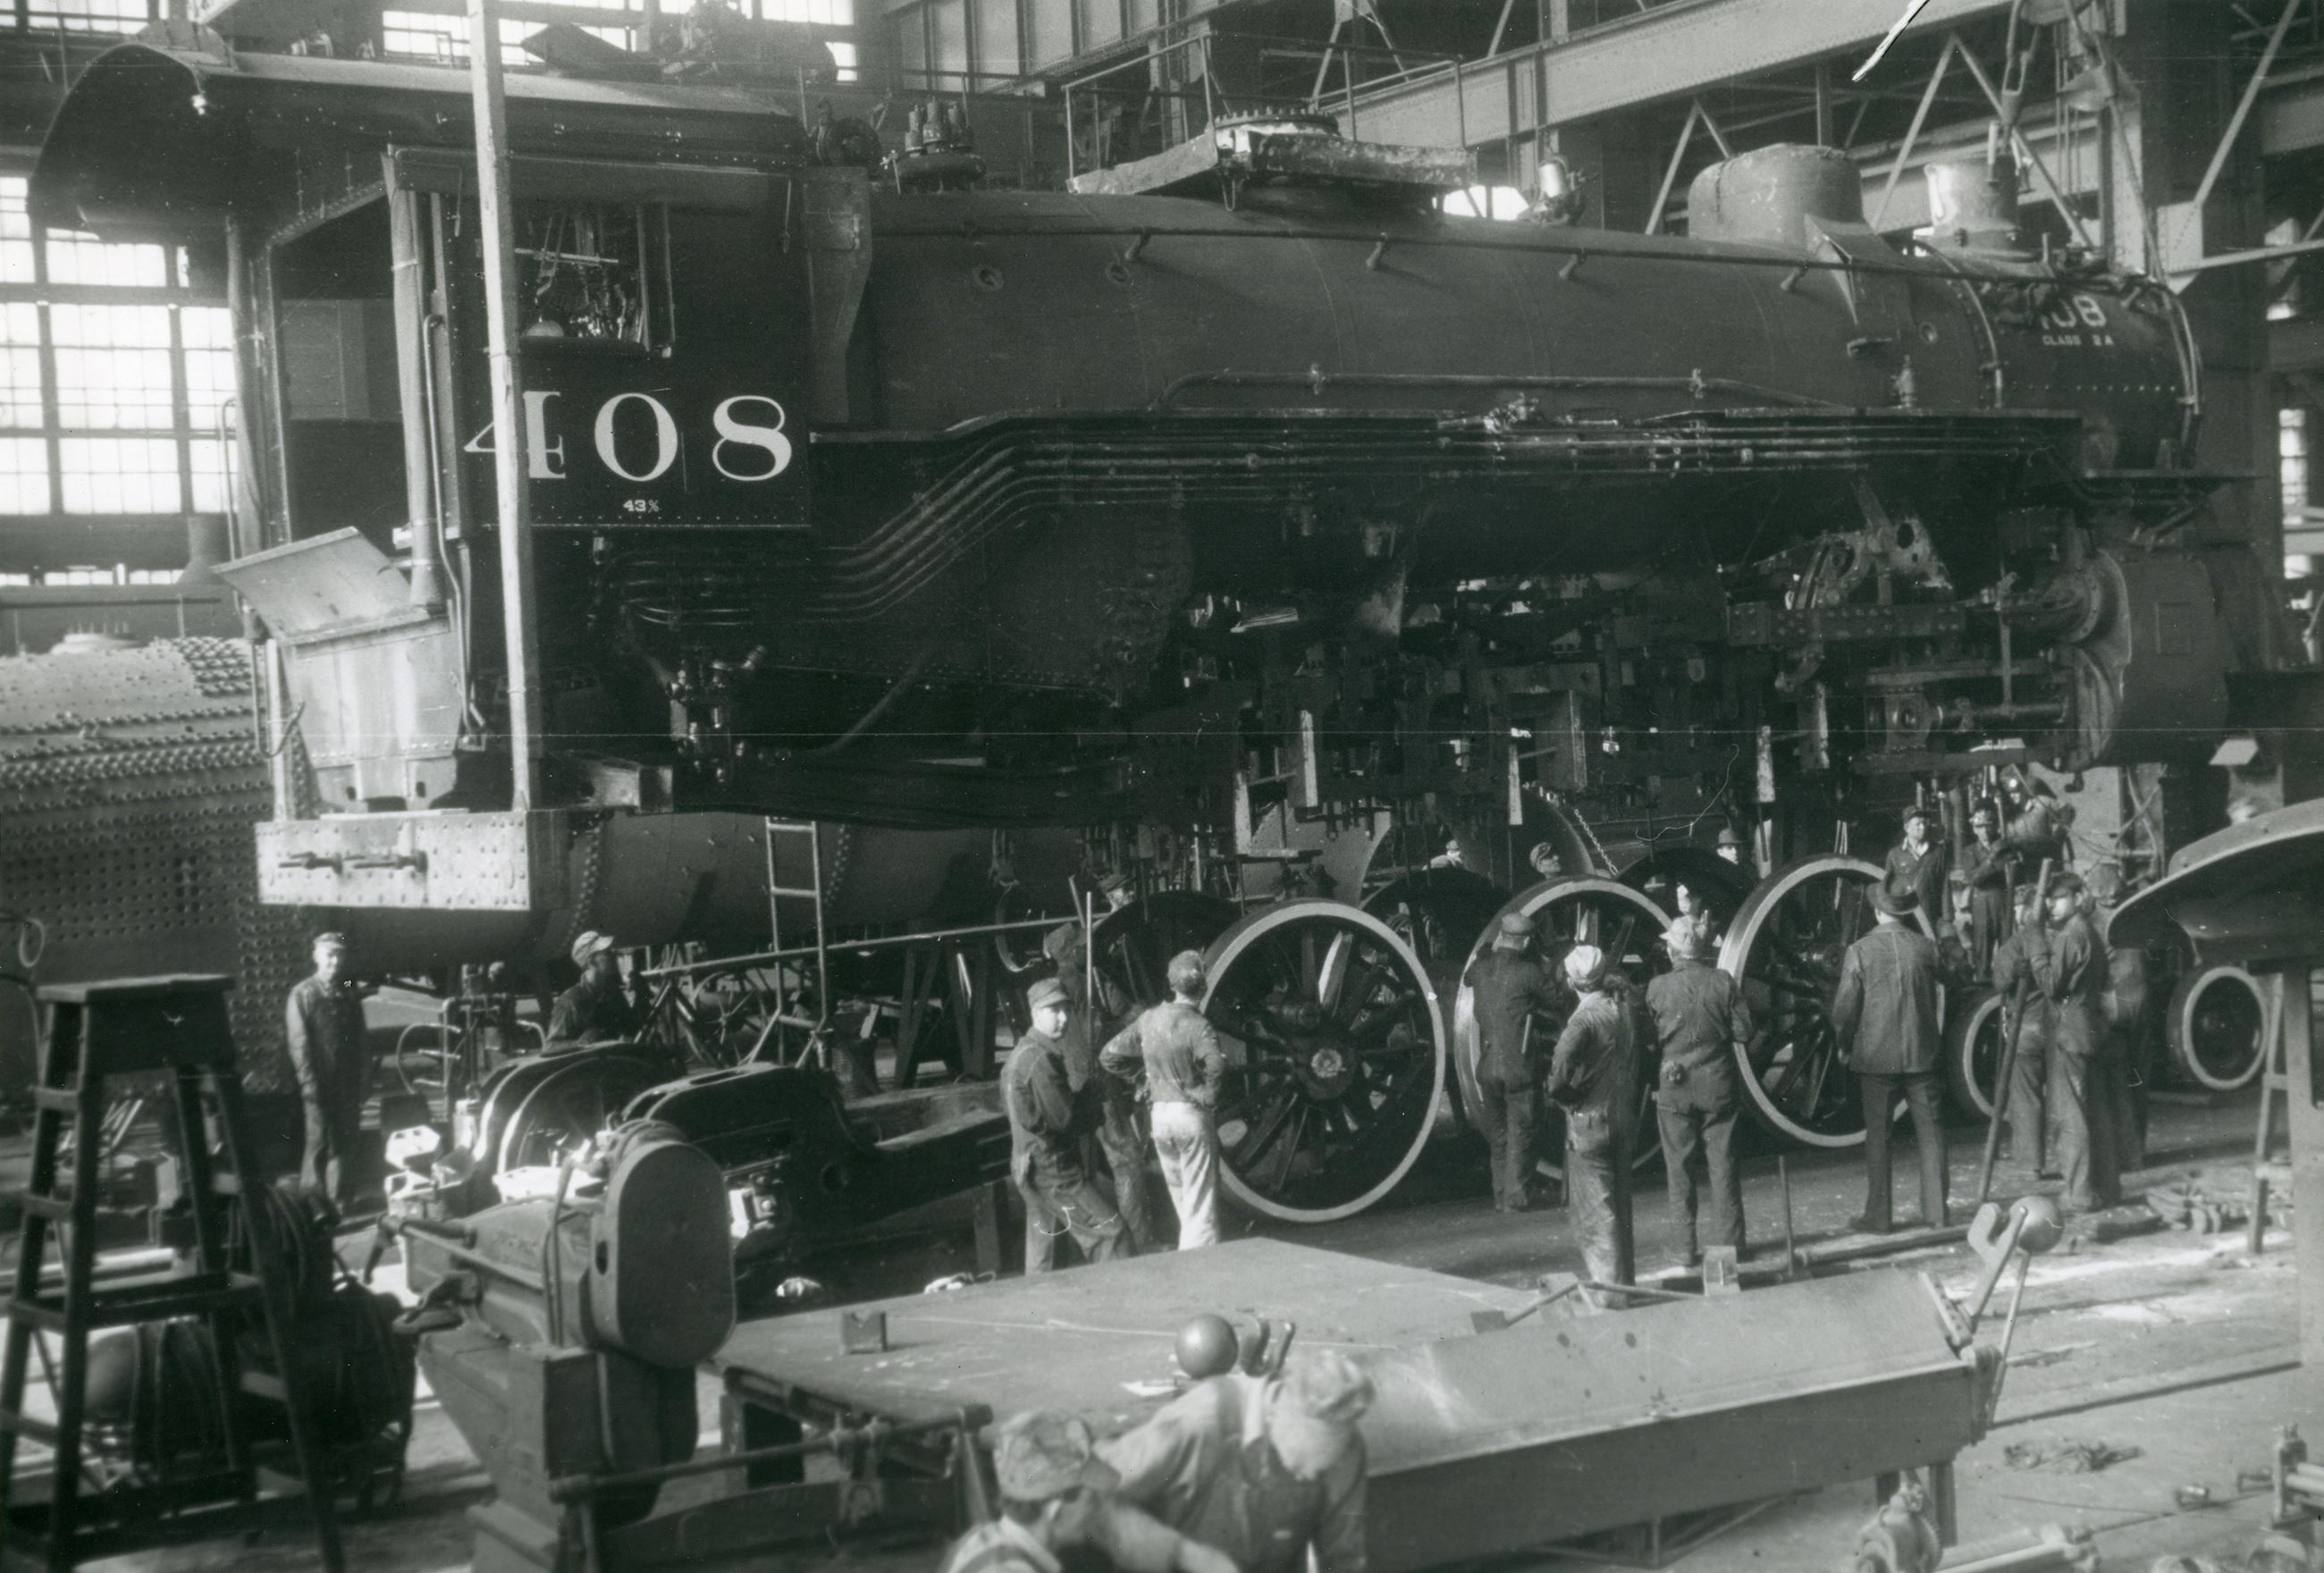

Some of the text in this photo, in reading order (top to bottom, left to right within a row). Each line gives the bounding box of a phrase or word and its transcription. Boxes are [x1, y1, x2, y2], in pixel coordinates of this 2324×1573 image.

[2041, 295, 2107, 330] 08
[2042, 333, 2081, 346] CLASS
[464, 391, 792, 482] 408
[623, 500, 659, 513] 43%
